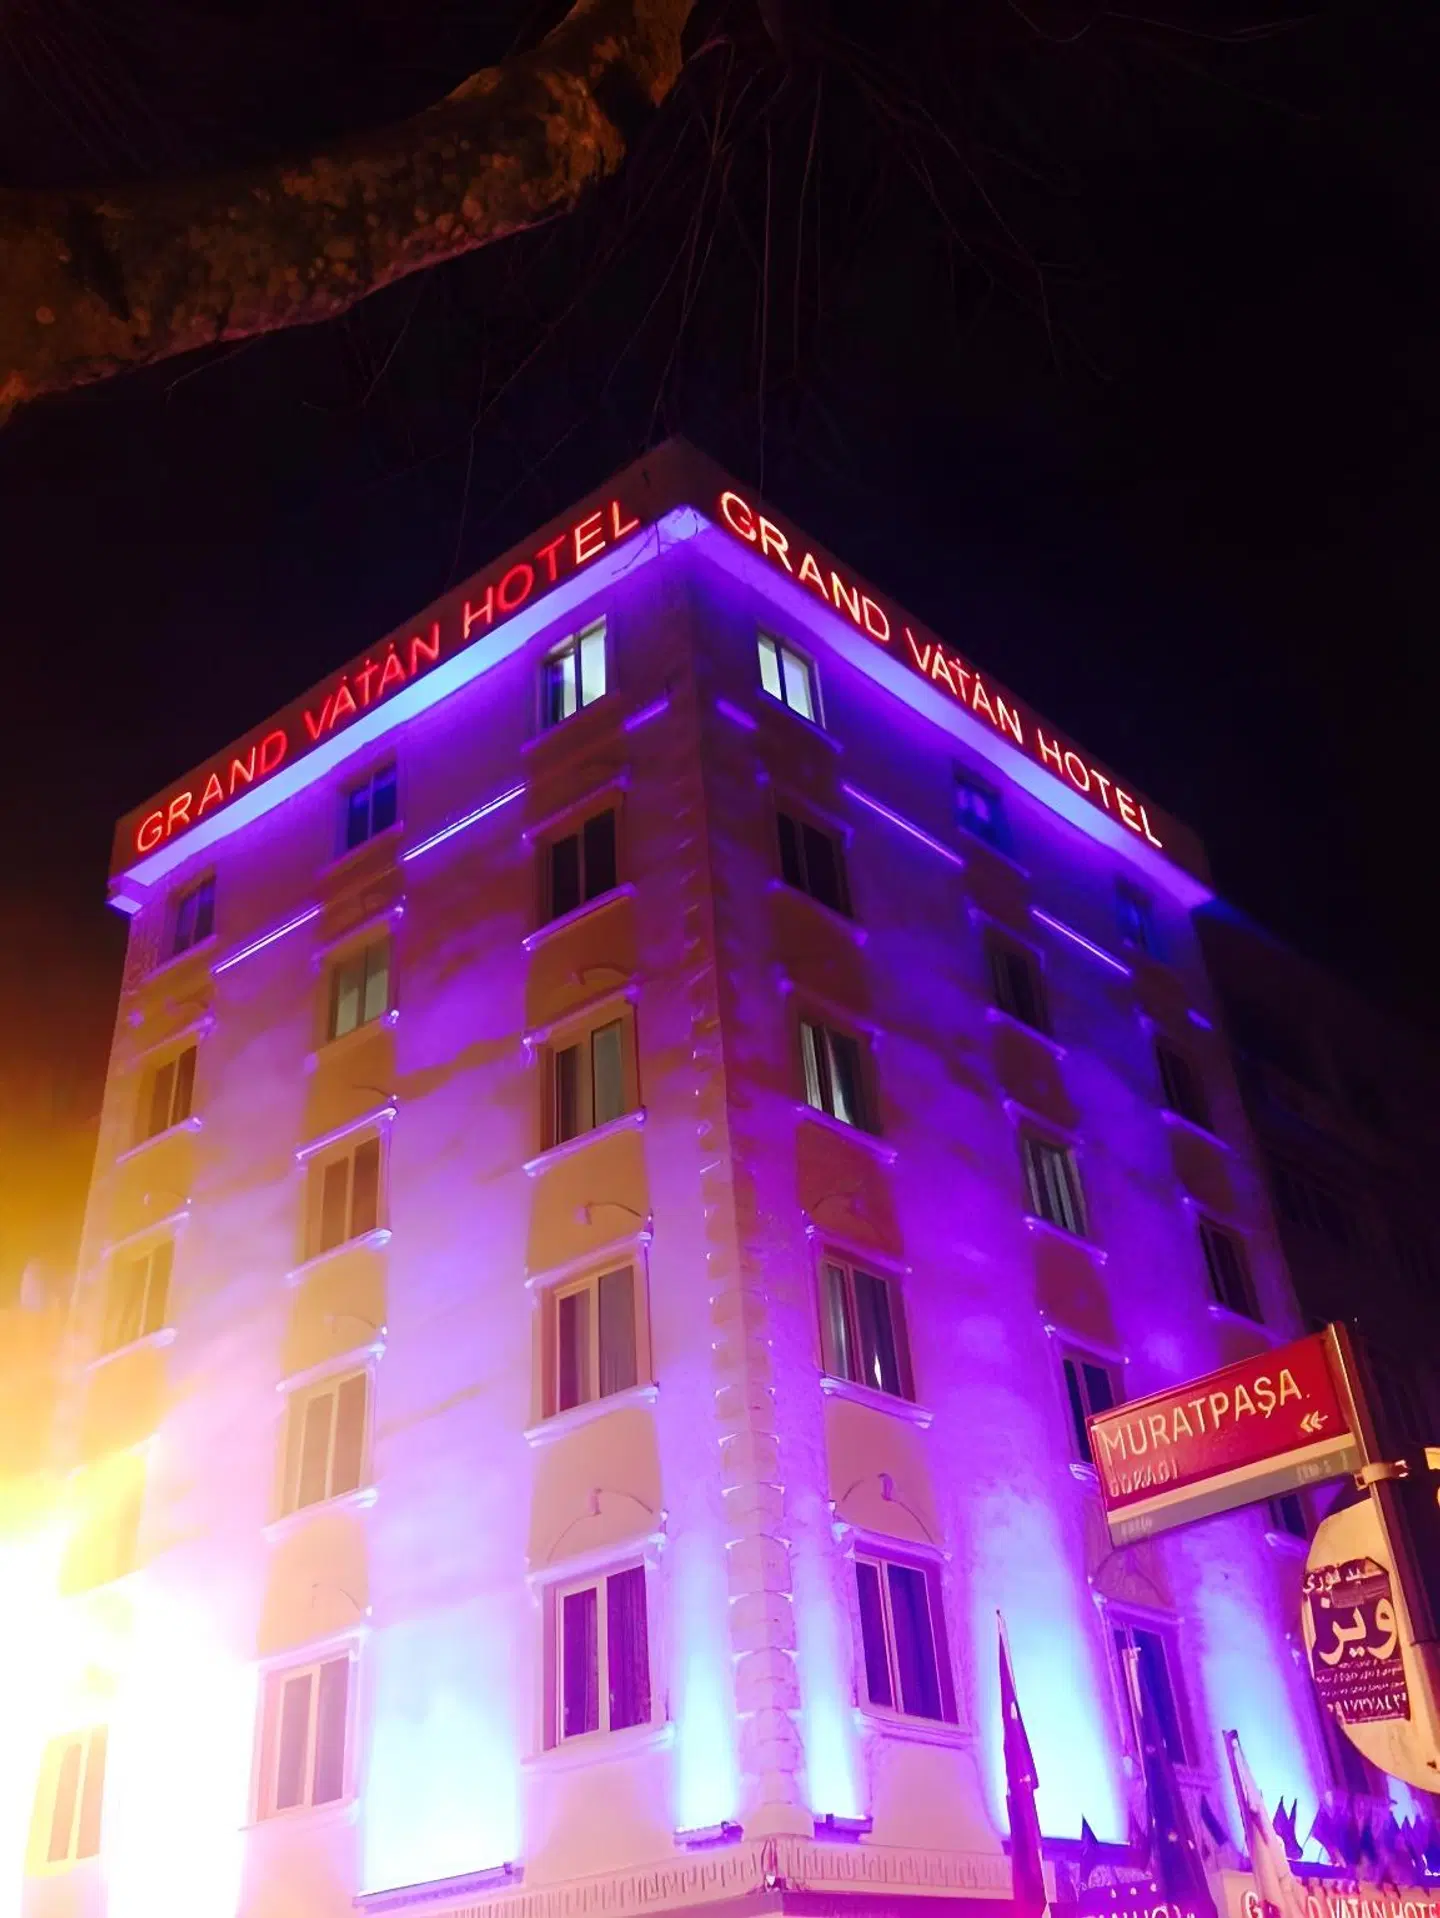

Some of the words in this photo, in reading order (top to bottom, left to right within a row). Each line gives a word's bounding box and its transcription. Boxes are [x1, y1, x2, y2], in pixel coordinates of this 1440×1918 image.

[136, 729, 289, 853] GRAND
[461, 500, 641, 640] HOTEL
[720, 491, 891, 642] GRAND
[1036, 728, 1163, 849] HOTEL
